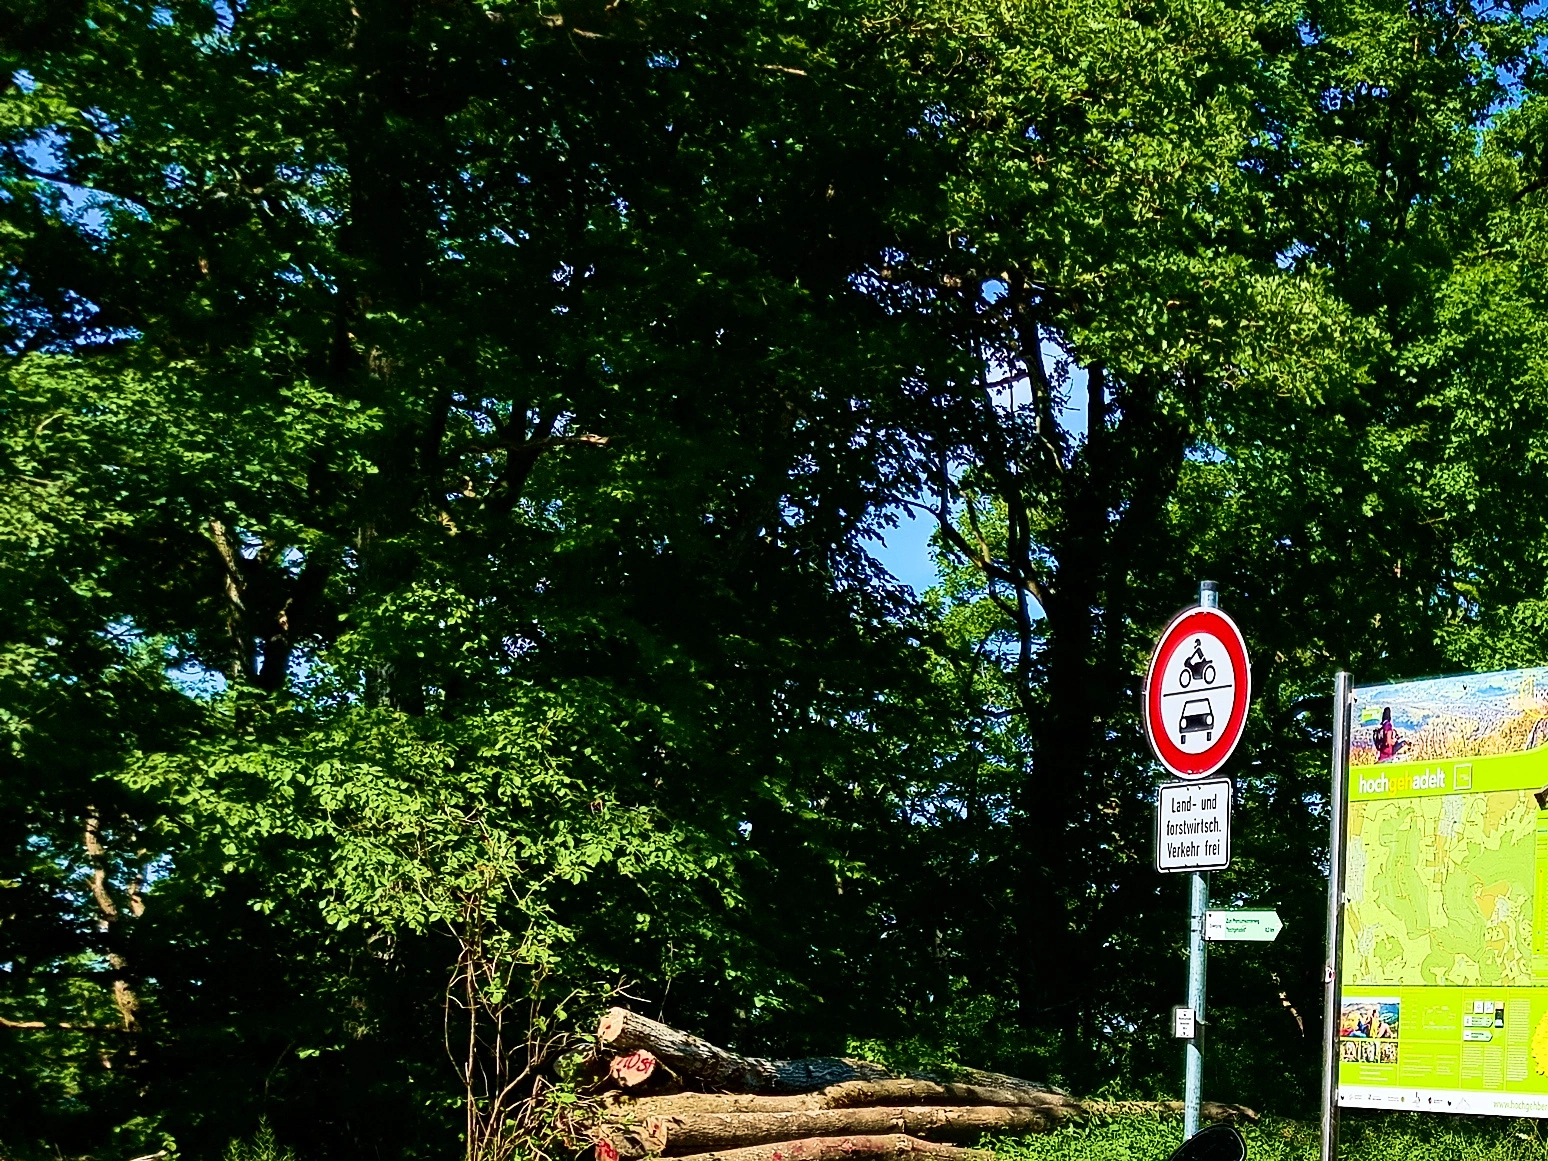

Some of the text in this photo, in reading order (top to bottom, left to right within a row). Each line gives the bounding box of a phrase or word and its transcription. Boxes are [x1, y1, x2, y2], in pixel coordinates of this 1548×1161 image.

[1358, 766, 1446, 796] hochgehadelt
[1171, 793, 1217, 813] Land- und
[1166, 816, 1222, 836] forstwirtsch.
[1167, 839, 1220, 858] Verkehr frei
